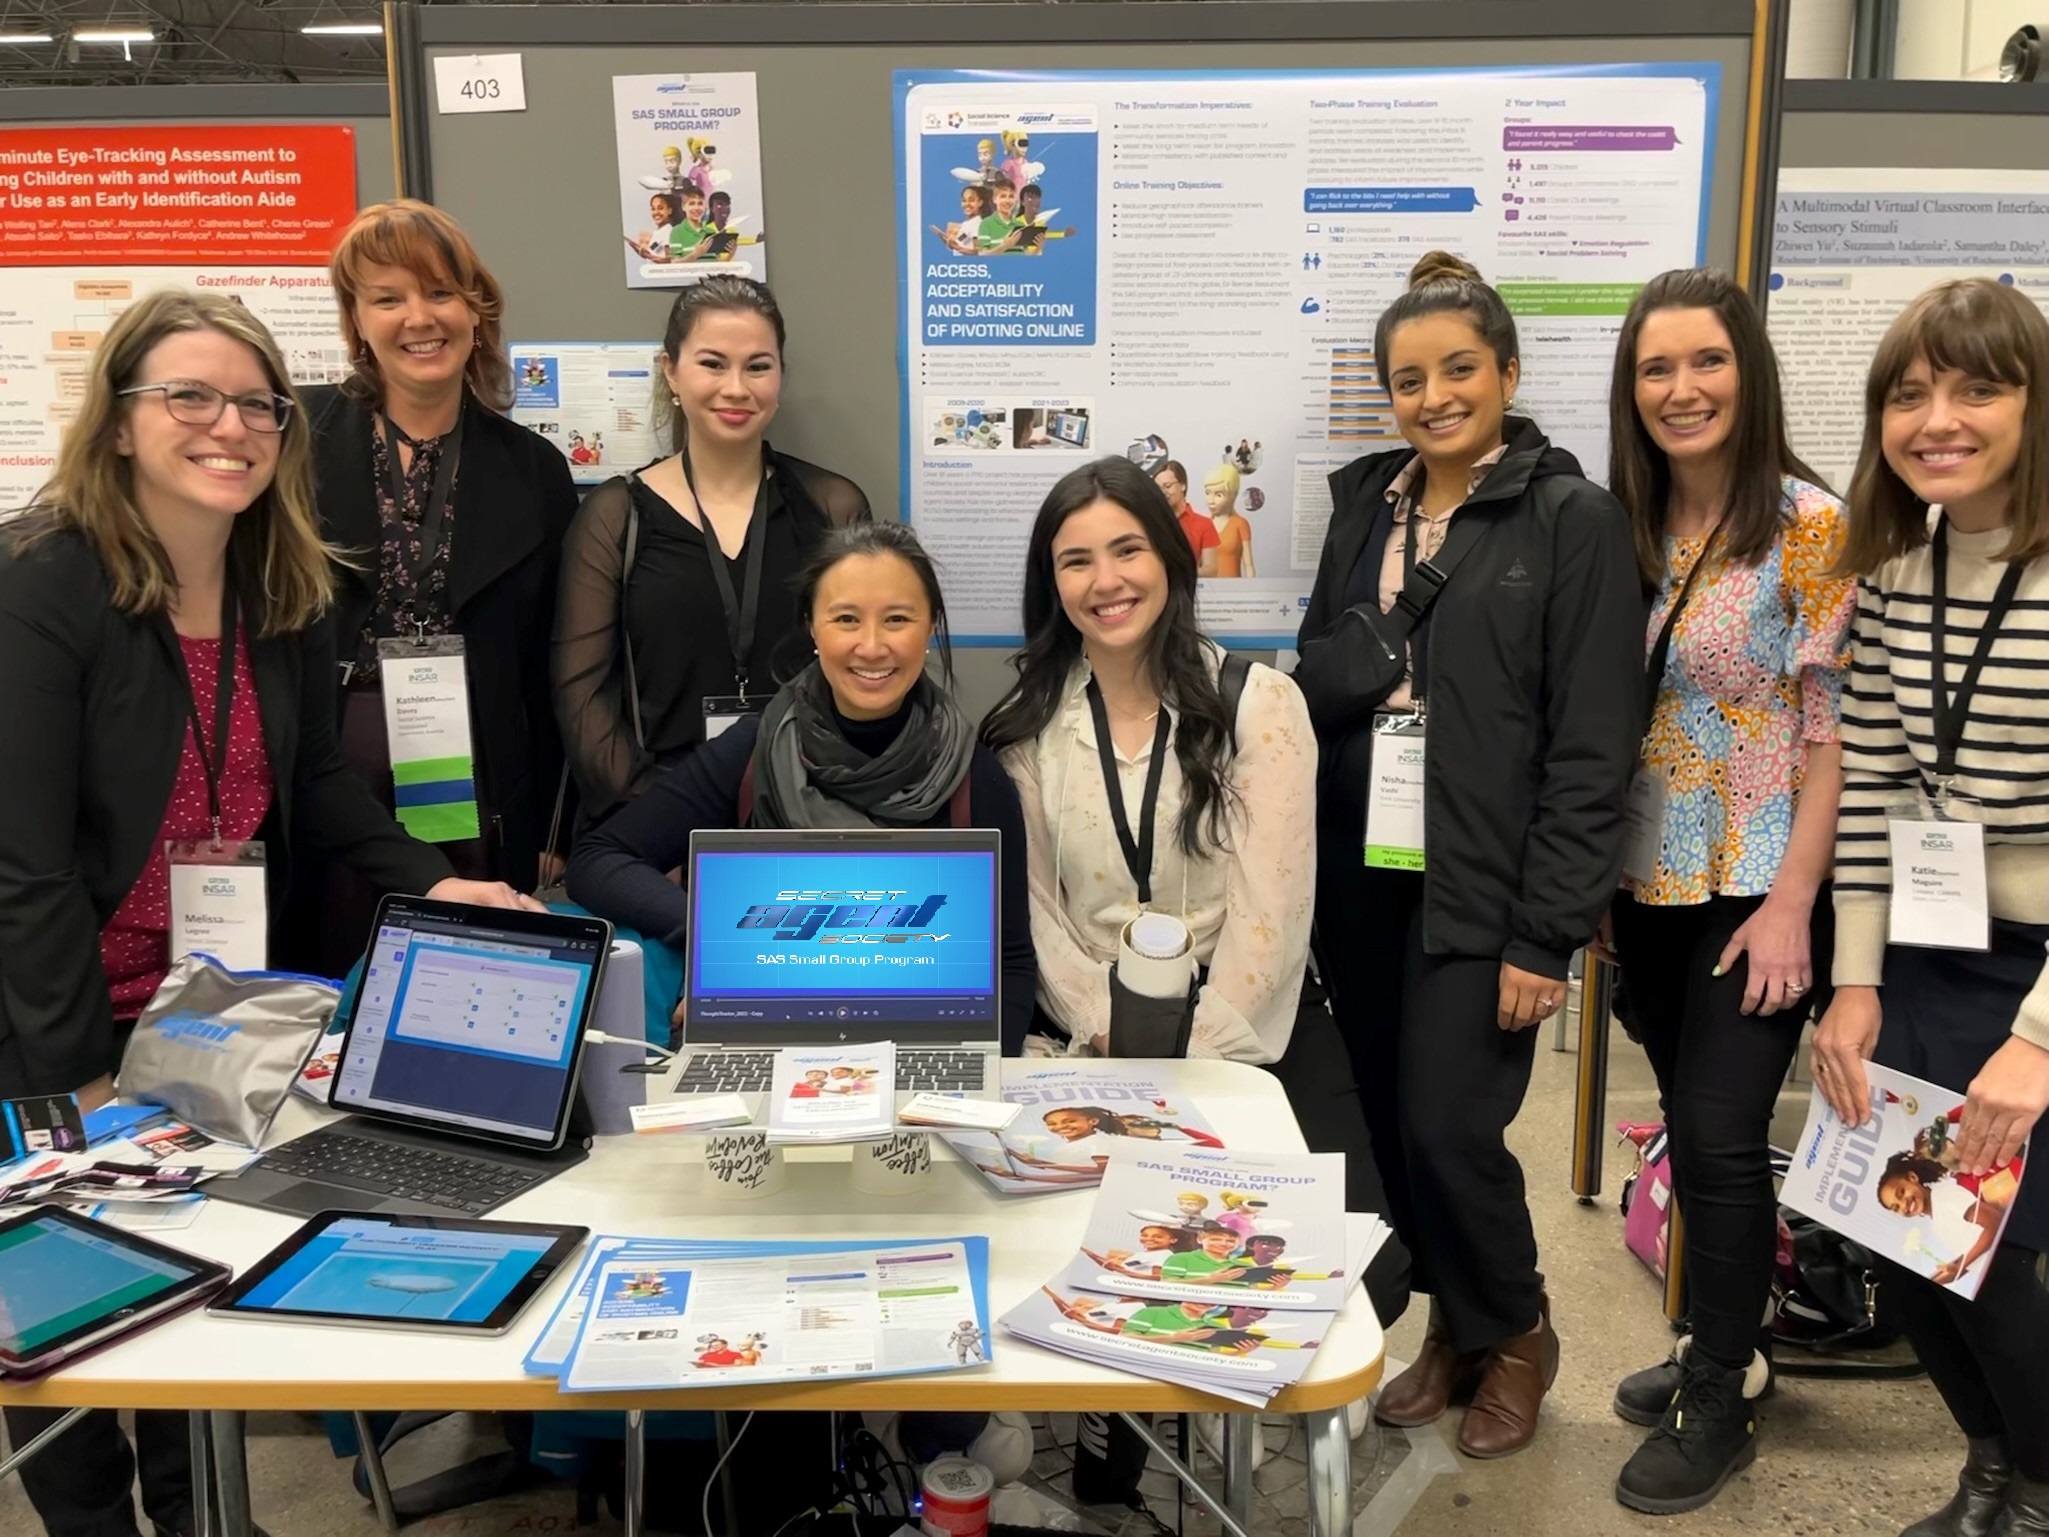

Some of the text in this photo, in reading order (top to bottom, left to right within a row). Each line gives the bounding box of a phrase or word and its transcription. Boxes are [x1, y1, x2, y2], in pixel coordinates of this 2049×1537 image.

[460, 79, 500, 99] 403
[1115, 102, 1252, 111] The Transformation Imperatives:
[1358, 100, 1391, 109] Training
[1536, 99, 1566, 107] Impact
[632, 107, 741, 119] SAS SMALL GROUP
[654, 120, 720, 130] PROGRAM?
[0, 147, 296, 167] minute Eye-Tracking Assessment to
[23, 170, 94, 186] Children
[98, 170, 133, 185] with
[137, 170, 169, 184] and
[174, 169, 237, 184] without
[241, 169, 301, 184] Autism
[1113, 180, 1224, 190] Online Training Objectives:
[10, 193, 43, 208] Use
[47, 195, 66, 208] as
[71, 195, 91, 207] an
[96, 191, 138, 210] Early
[143, 191, 253, 206] Identification
[258, 191, 296, 206] Aide
[1777, 200, 1788, 212] A
[1792, 200, 1870, 213] Multimodal
[1874, 200, 1919, 213] Virtual
[1923, 200, 1993, 213] Classroom
[1777, 220, 1898, 236] to Sensory Stimuli
[1954, 240, 2006, 251] Samantha
[1600, 250, 1627, 258] Solving
[927, 264, 991, 279] ACCESS,
[197, 275, 267, 287] Gazefinder
[1787, 278, 1843, 287] Background
[927, 284, 1043, 297] ACCEPTABILITY
[927, 304, 1074, 317] AND SATISFACTION
[928, 324, 1084, 337] OF PIVOTING ONLINE
[409, 673, 438, 682] INSAR
[397, 695, 436, 705] Kathleen
[1381, 776, 1406, 784] Nisha
[1920, 840, 1954, 849] INSAR
[1911, 866, 1937, 876] Katie
[202, 885, 236, 895] INSAR
[776, 890, 907, 901] SECRET
[185, 914, 224, 924] Melissa
[736, 894, 948, 941] agent
[819, 933, 951, 945] SOCIETY
[756, 954, 934, 966] SAS Small Group Program
[1001, 1080, 1154, 1092] IMPLEMENTATION
[1003, 1087, 1160, 1106] GUIDE
[1829, 1086, 1887, 1216] GUIDE
[1814, 1126, 1849, 1204] IMPLEMEN
[1137, 1161, 1316, 1185] SAS SMALL GROUP
[1170, 1173, 1279, 1192] PROGRAM?
[1113, 1278, 1300, 1301] www.secretagentsociety.com
[1066, 1327, 1258, 1369] www.secretagentsociety.com
